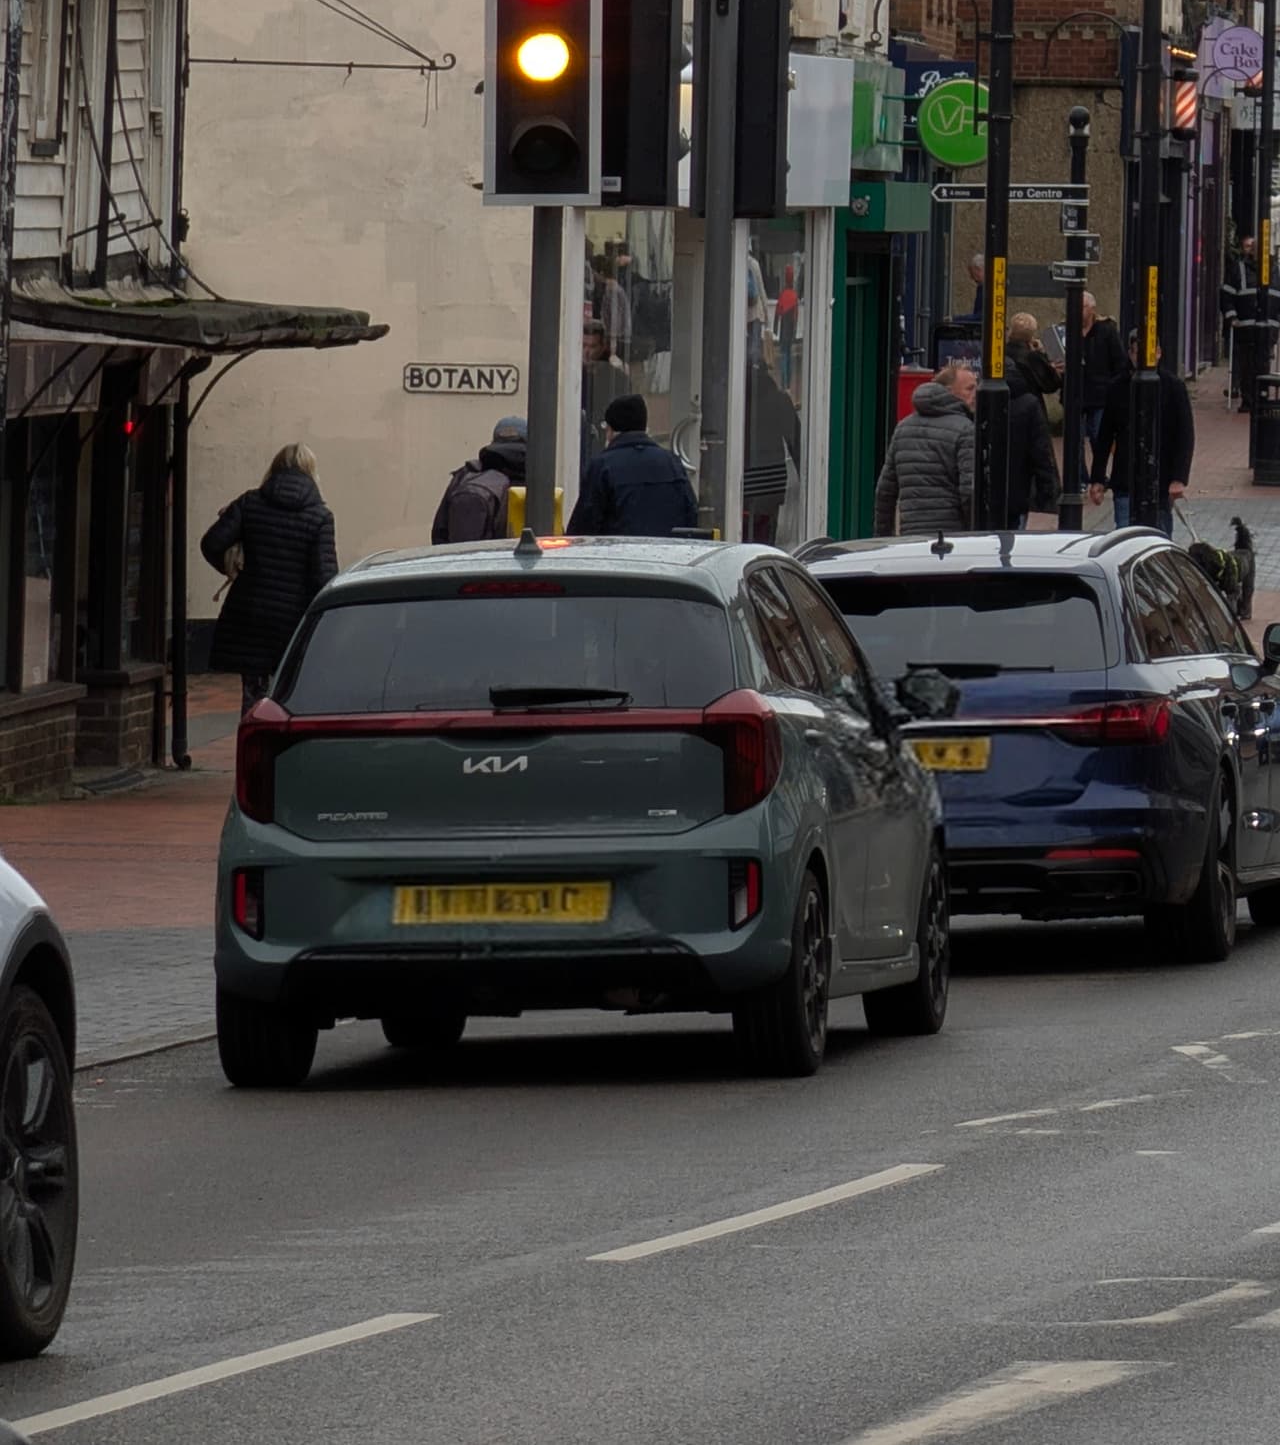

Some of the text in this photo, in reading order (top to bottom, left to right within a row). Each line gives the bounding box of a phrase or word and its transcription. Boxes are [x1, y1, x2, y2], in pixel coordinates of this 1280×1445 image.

[1220, 43, 1258, 58] Cake
[1234, 55, 1260, 68] Box
[1026, 188, 1063, 199] Centre
[409, 367, 512, 390] BOTANY
[463, 755, 528, 774] KIA
[317, 811, 388, 822] PICANTO
